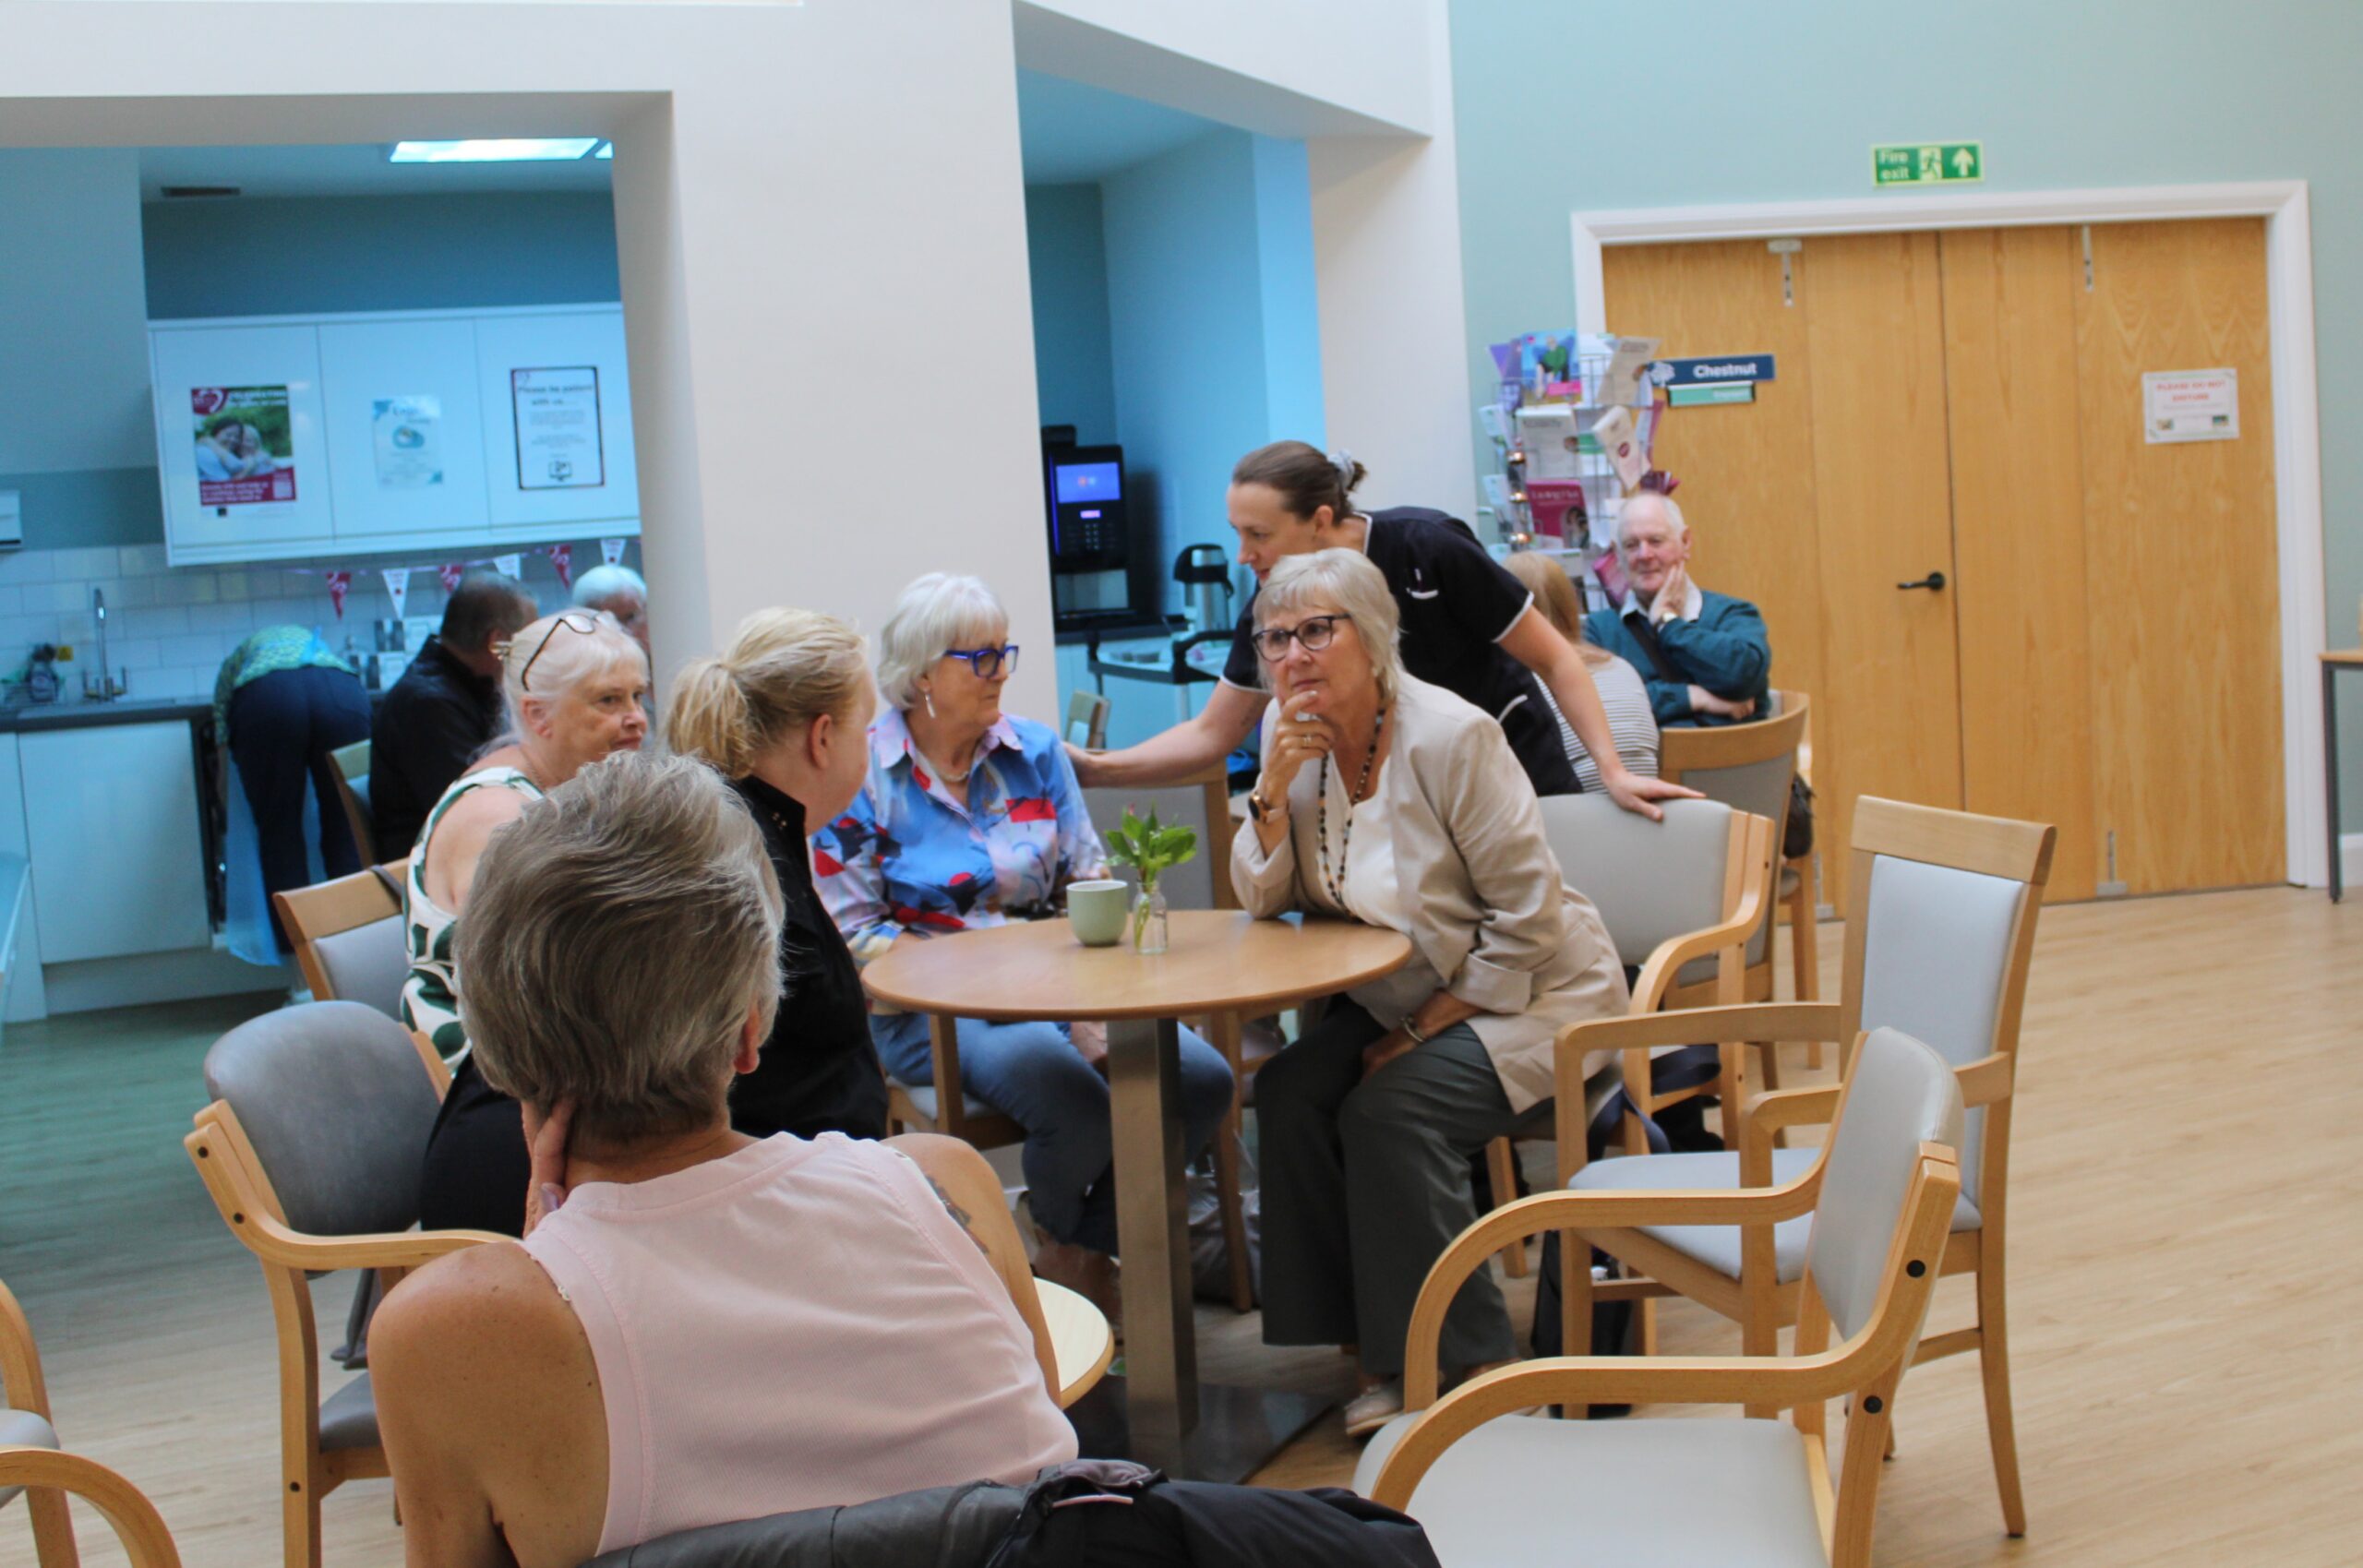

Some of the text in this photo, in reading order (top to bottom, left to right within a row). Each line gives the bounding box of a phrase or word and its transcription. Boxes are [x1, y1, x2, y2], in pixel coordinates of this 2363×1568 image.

[1879, 148, 1909, 164] Fire
[1880, 166, 1909, 180] exit
[1693, 362, 1757, 379] Chestnut
